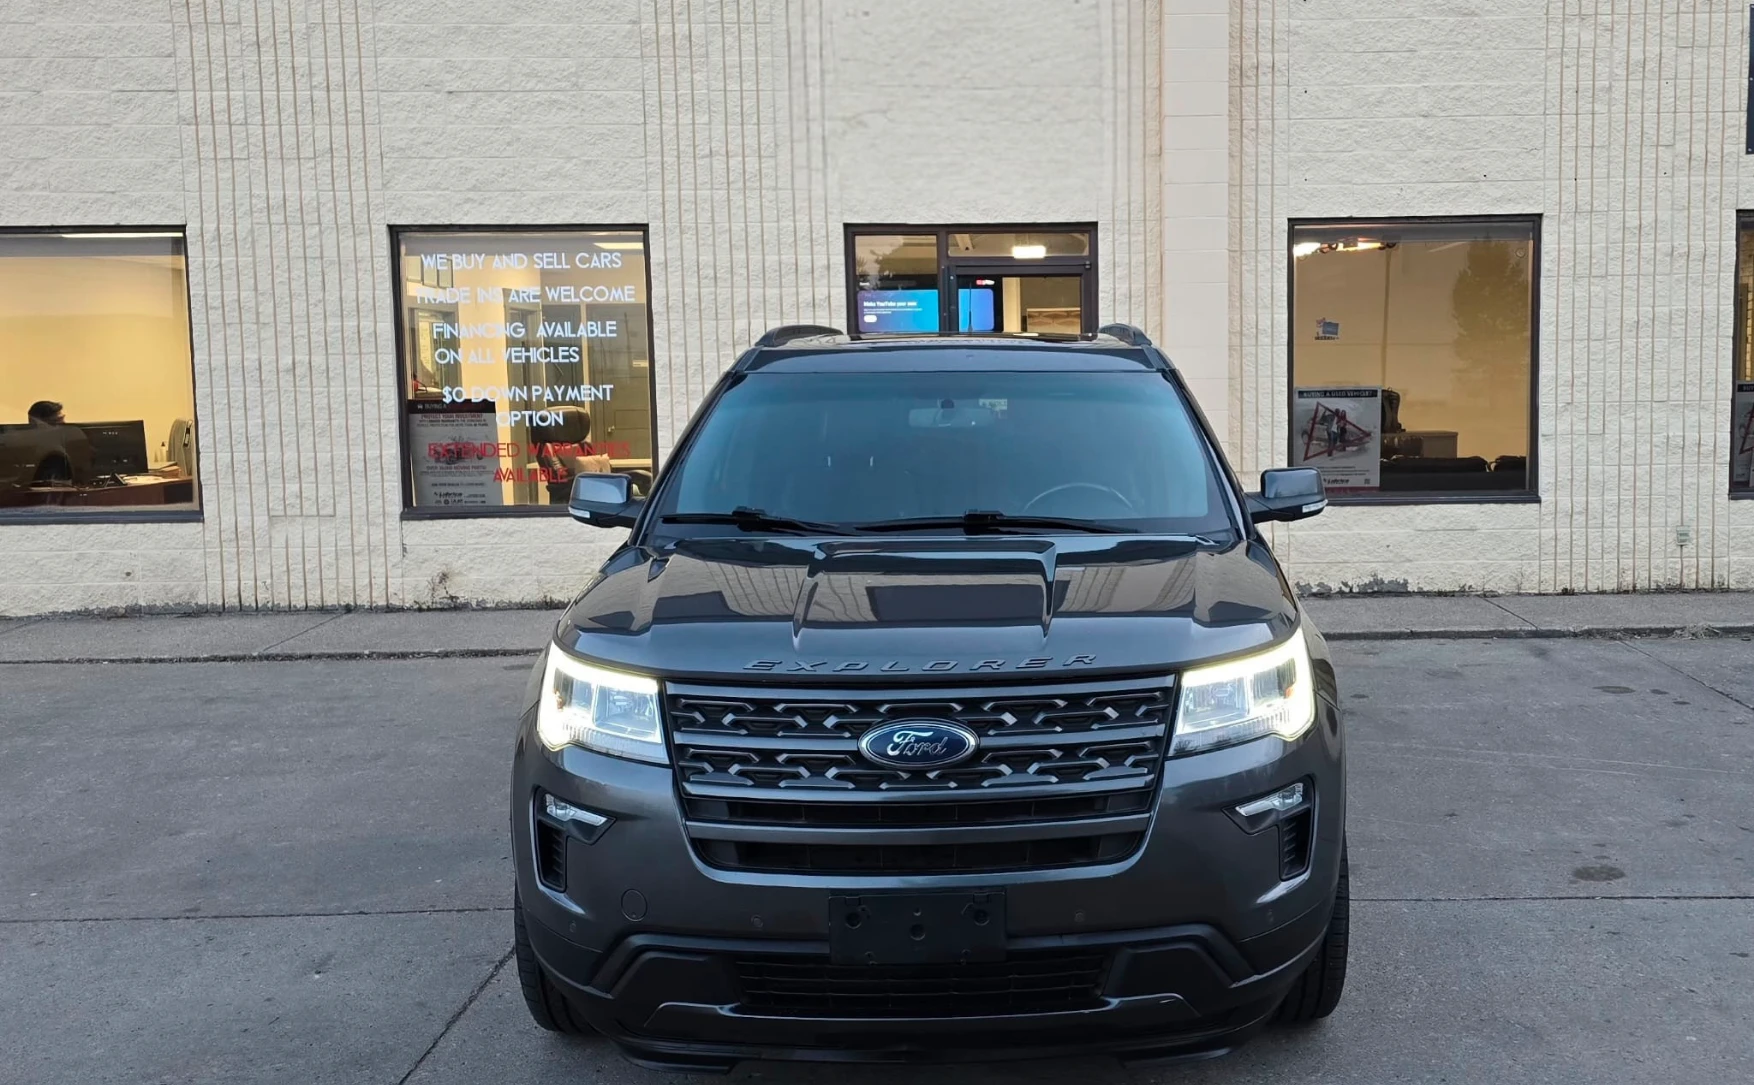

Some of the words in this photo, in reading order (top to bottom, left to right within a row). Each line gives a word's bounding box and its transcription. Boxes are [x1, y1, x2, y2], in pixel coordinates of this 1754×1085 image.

[421, 253, 448, 270] WE
[452, 253, 485, 270] BUY
[492, 253, 528, 270] AND
[533, 253, 570, 269] SELL
[575, 252, 622, 268] CARS
[416, 287, 470, 304] TRADE
[477, 286, 503, 303] INS
[508, 286, 540, 303] ARE
[545, 286, 636, 302] WELCOME
[432, 322, 525, 339] FINANCING
[536, 321, 617, 338] AVAILABLE
[434, 348, 462, 364] ON
[468, 348, 496, 364] ALL
[502, 347, 580, 363] VEHICLES
[470, 385, 528, 403] DOWN
[532, 384, 614, 402] PAYMENT
[496, 410, 564, 427] OPTION
[428, 442, 520, 458] EXTENDED
[528, 442, 631, 458] WARRANTIES
[493, 468, 568, 483] AVAILABLE
[743, 654, 1097, 673] EXPLORER
[886, 731, 948, 756] Ford
